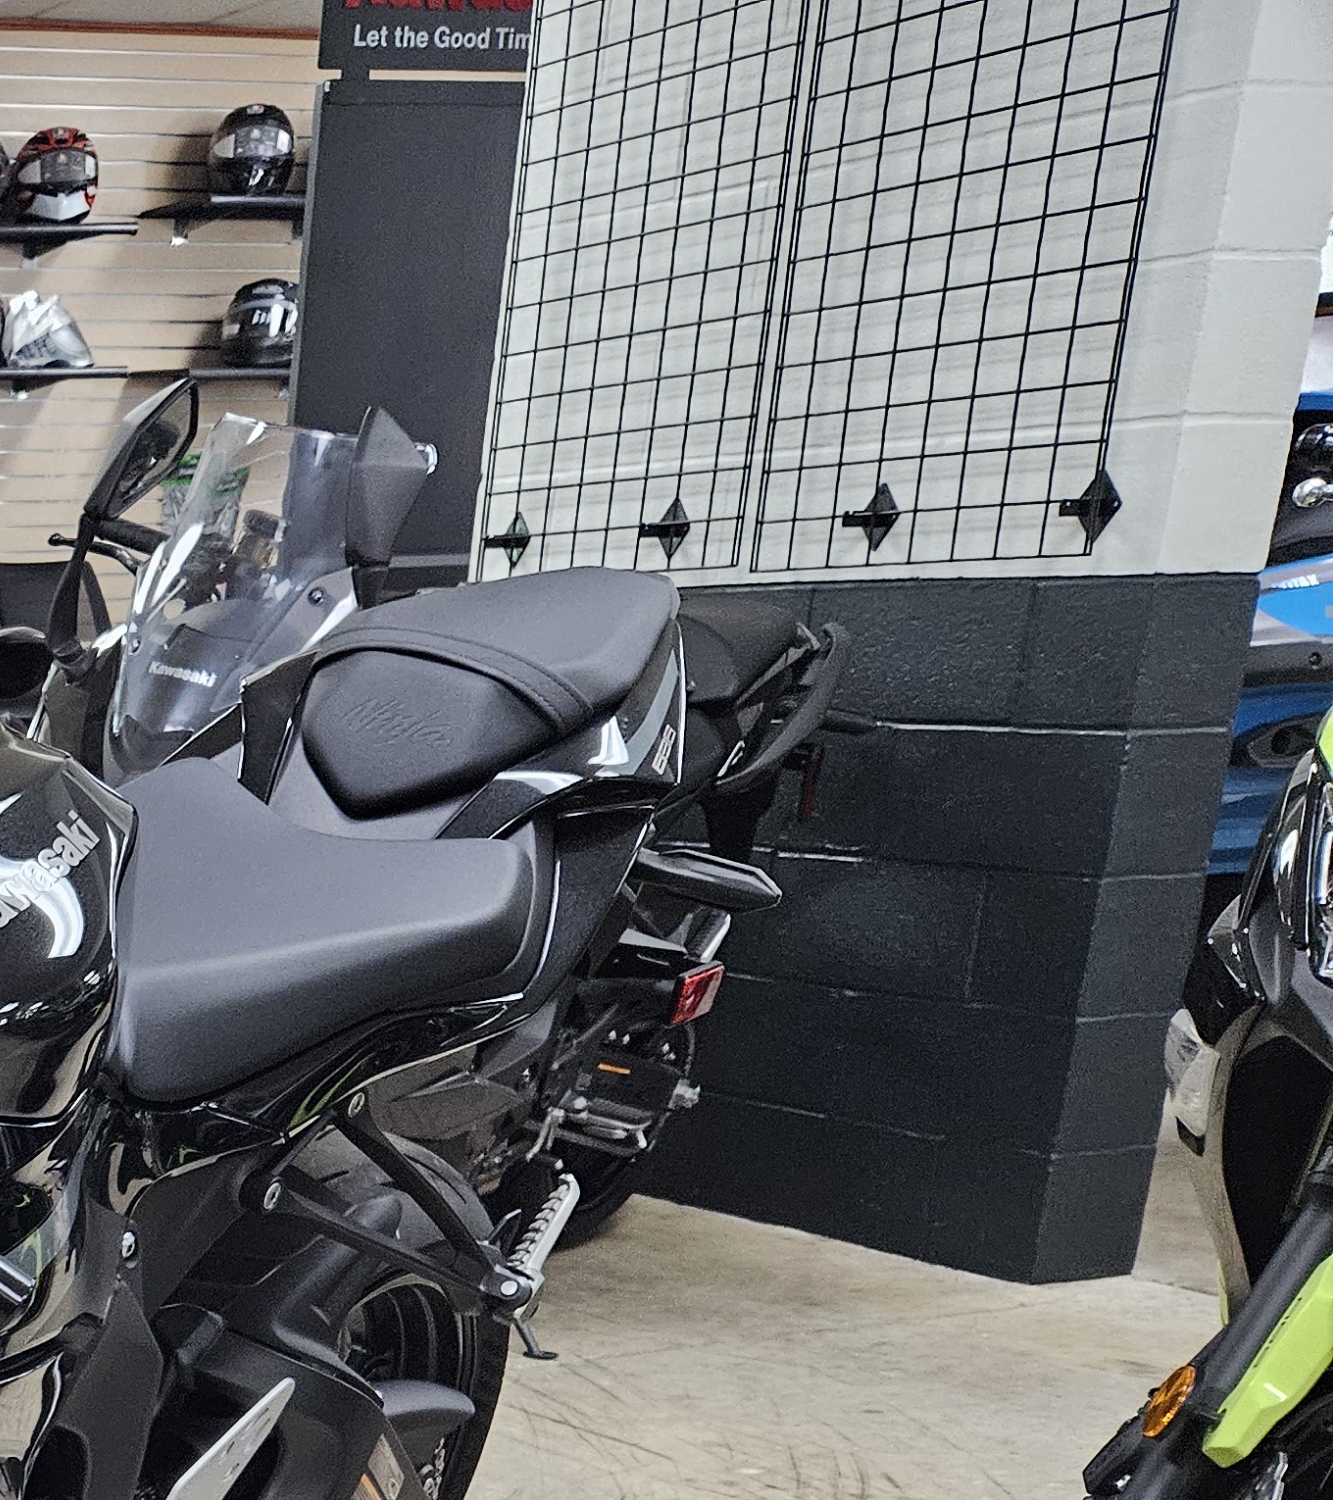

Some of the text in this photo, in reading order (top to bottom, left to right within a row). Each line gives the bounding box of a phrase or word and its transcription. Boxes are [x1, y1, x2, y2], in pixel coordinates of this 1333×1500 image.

[353, 23, 388, 47] Let
[394, 25, 429, 48] the
[434, 25, 491, 49] Good
[148, 660, 217, 688] Kawasaki
